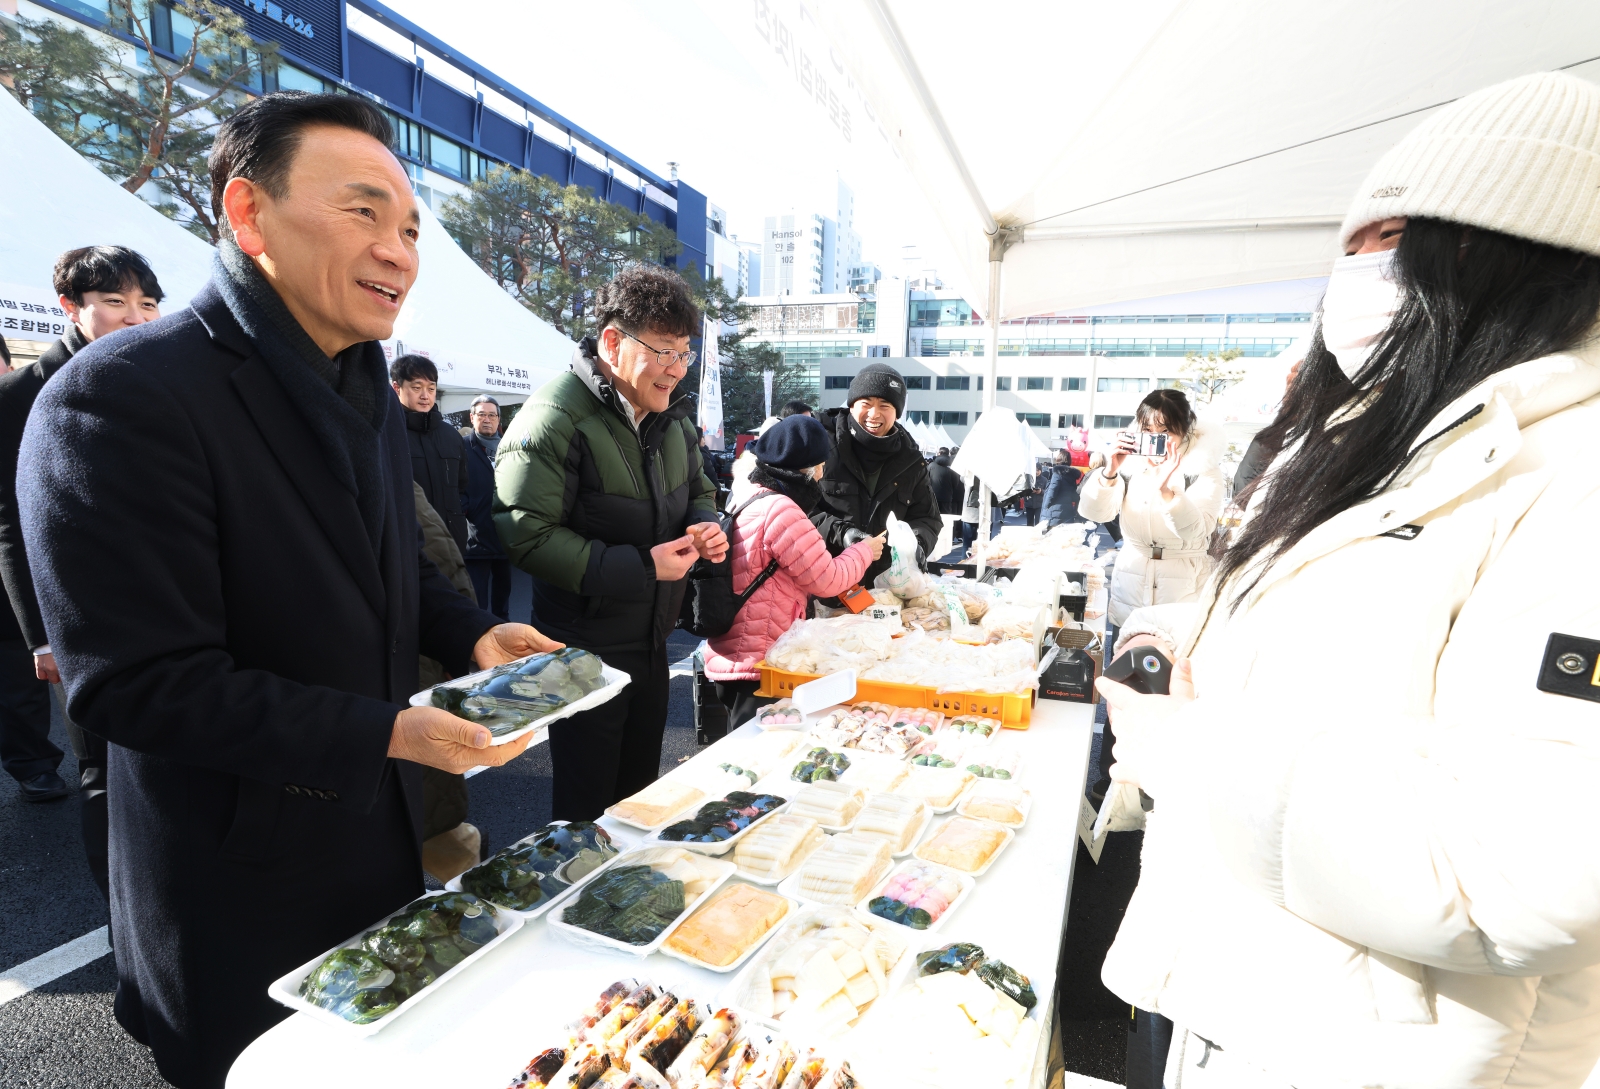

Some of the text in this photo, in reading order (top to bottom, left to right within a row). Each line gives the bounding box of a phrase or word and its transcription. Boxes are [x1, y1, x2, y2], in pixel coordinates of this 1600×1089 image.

[284, 13, 314, 39] 426
[771, 229, 803, 239] Hansol
[781, 255, 794, 264] 102
[20, 302, 68, 317] 감귤·한
[0, 316, 65, 336] 조합법인
